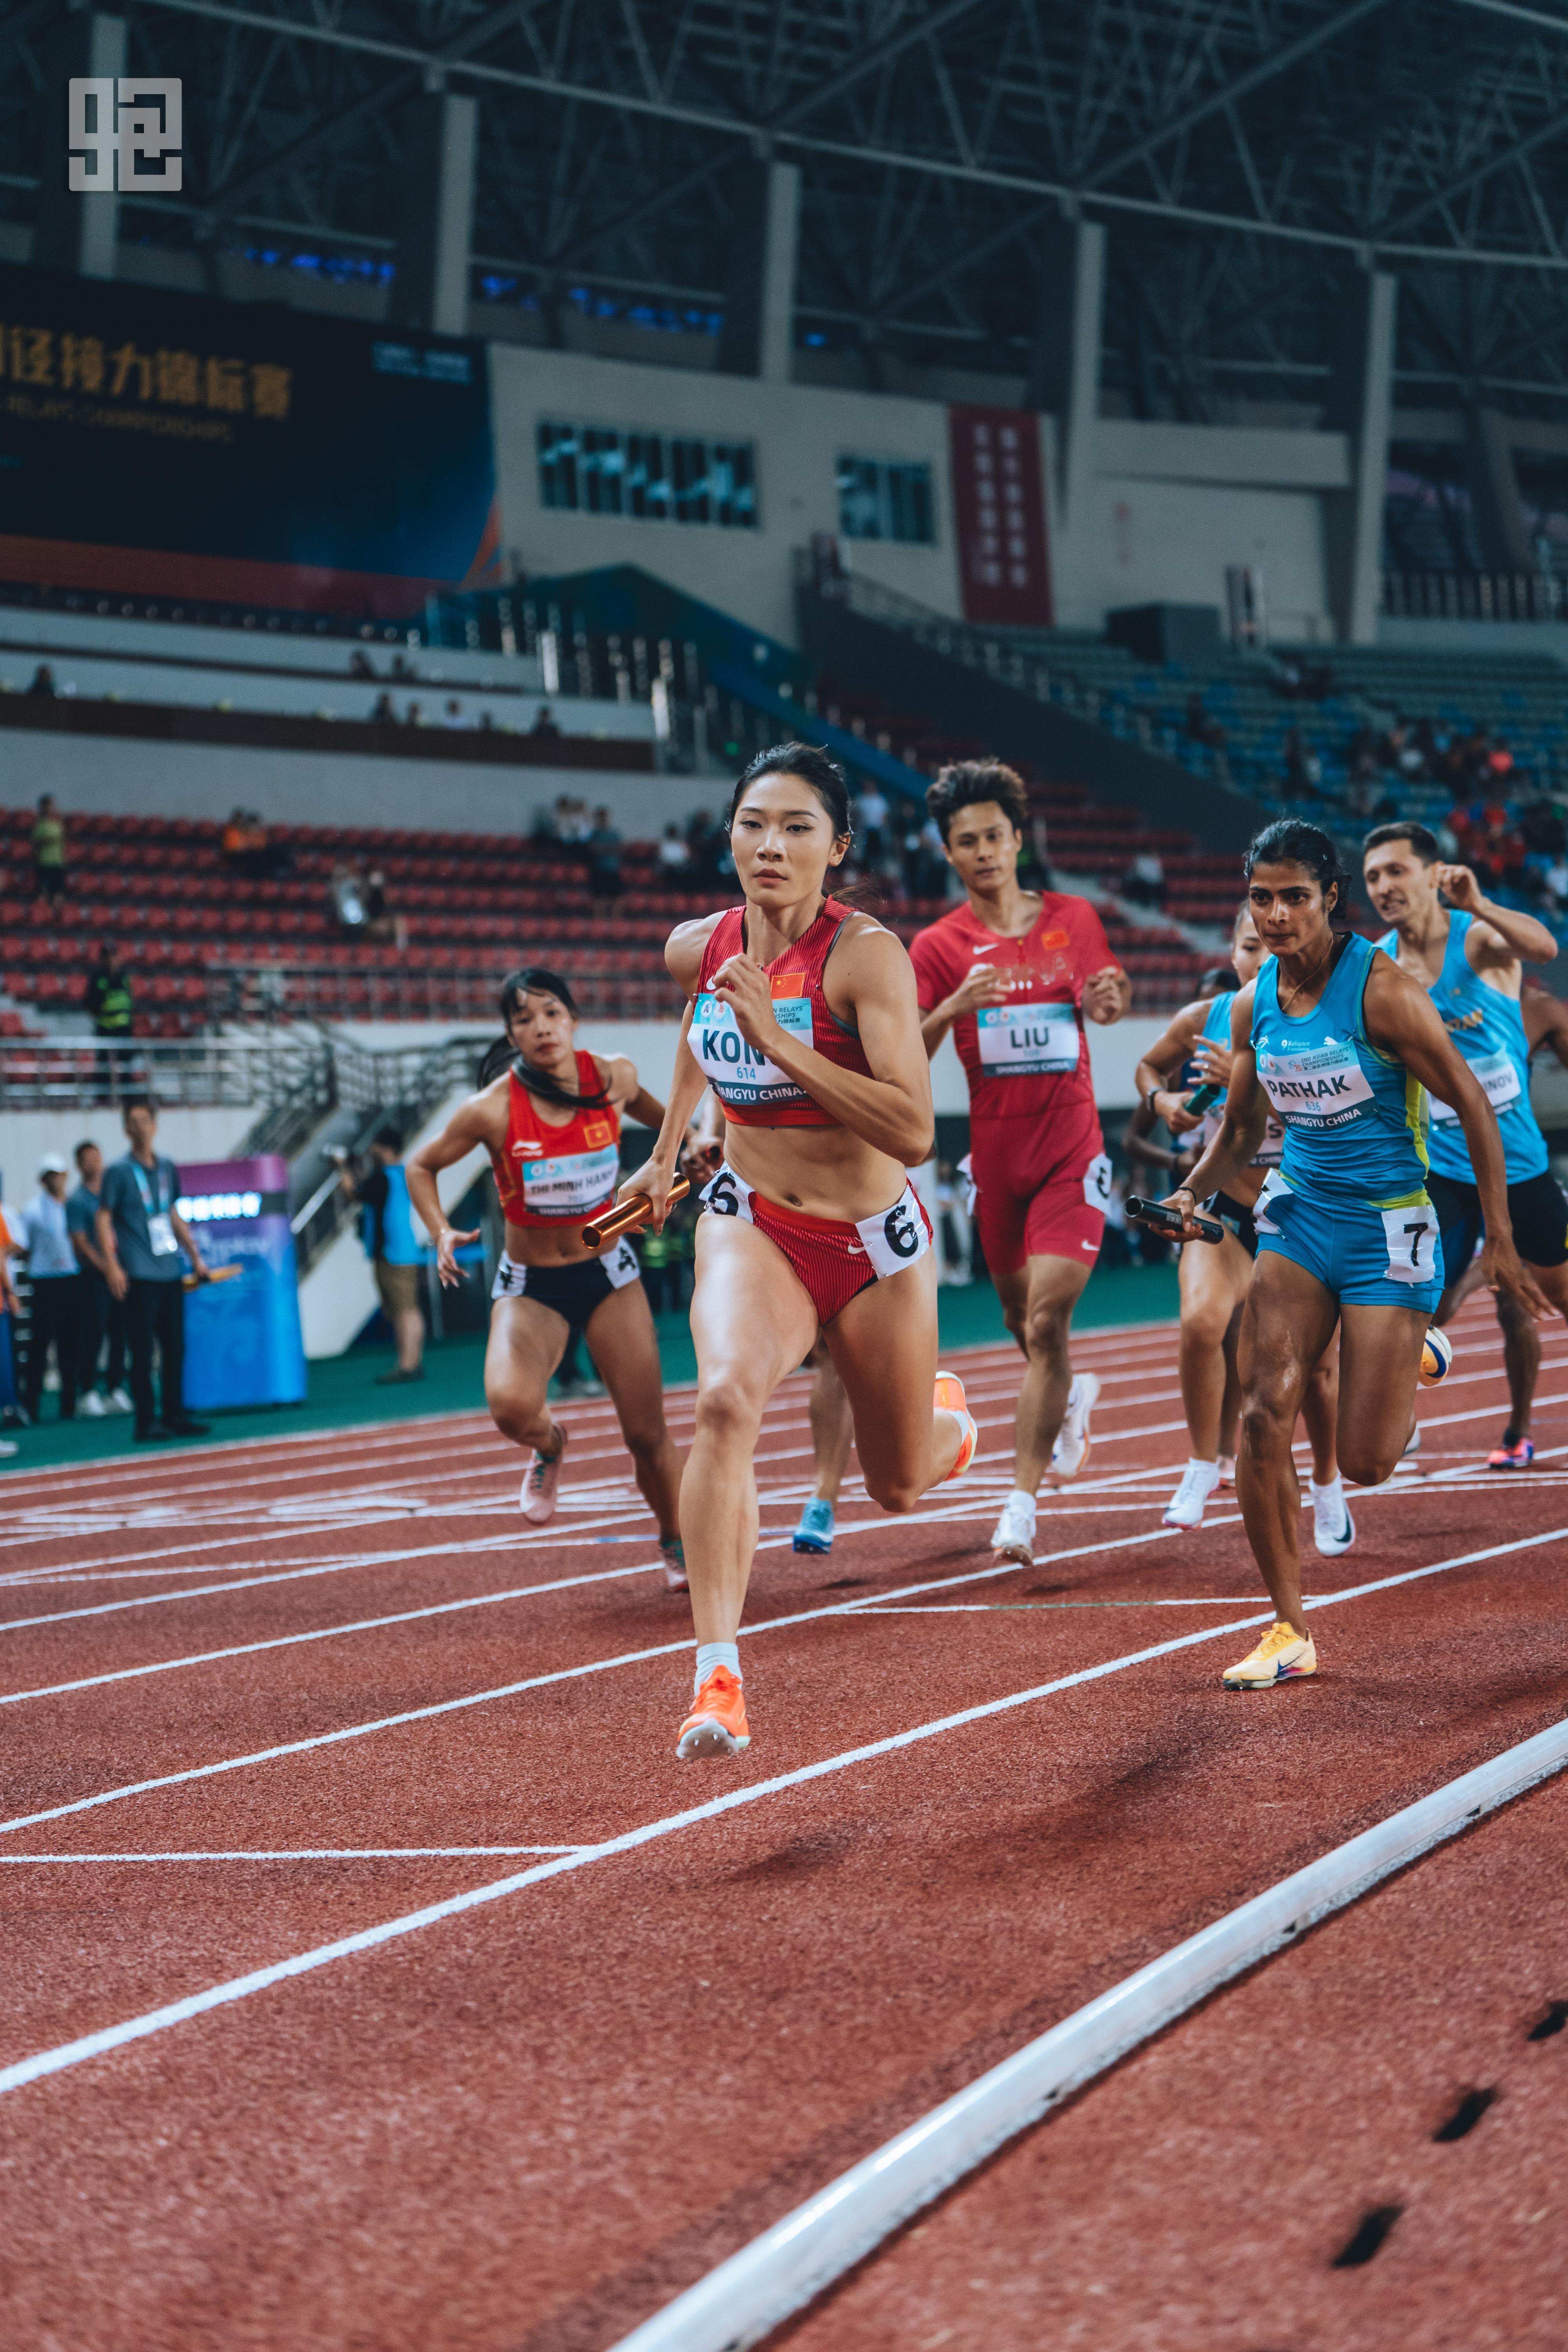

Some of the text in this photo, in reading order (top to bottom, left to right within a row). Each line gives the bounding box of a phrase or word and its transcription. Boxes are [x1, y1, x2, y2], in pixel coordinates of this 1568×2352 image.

[0, 321, 292, 419] 径接力锦标赛
[702, 1029, 765, 1066] KON
[1010, 1027, 1049, 1049] LIU
[1302, 1053, 1344, 1067] CHAMPIONSHIPS
[737, 1067, 756, 1080] 614
[719, 1086, 803, 1101] ANGYU CHINA
[1267, 1075, 1352, 1098] PATHAK
[1305, 1101, 1321, 1111] 636
[1285, 1109, 1362, 1127] SHANGYU CHINA
[708, 1172, 918, 1258] 6 6
[1403, 1222, 1428, 1267] 7
